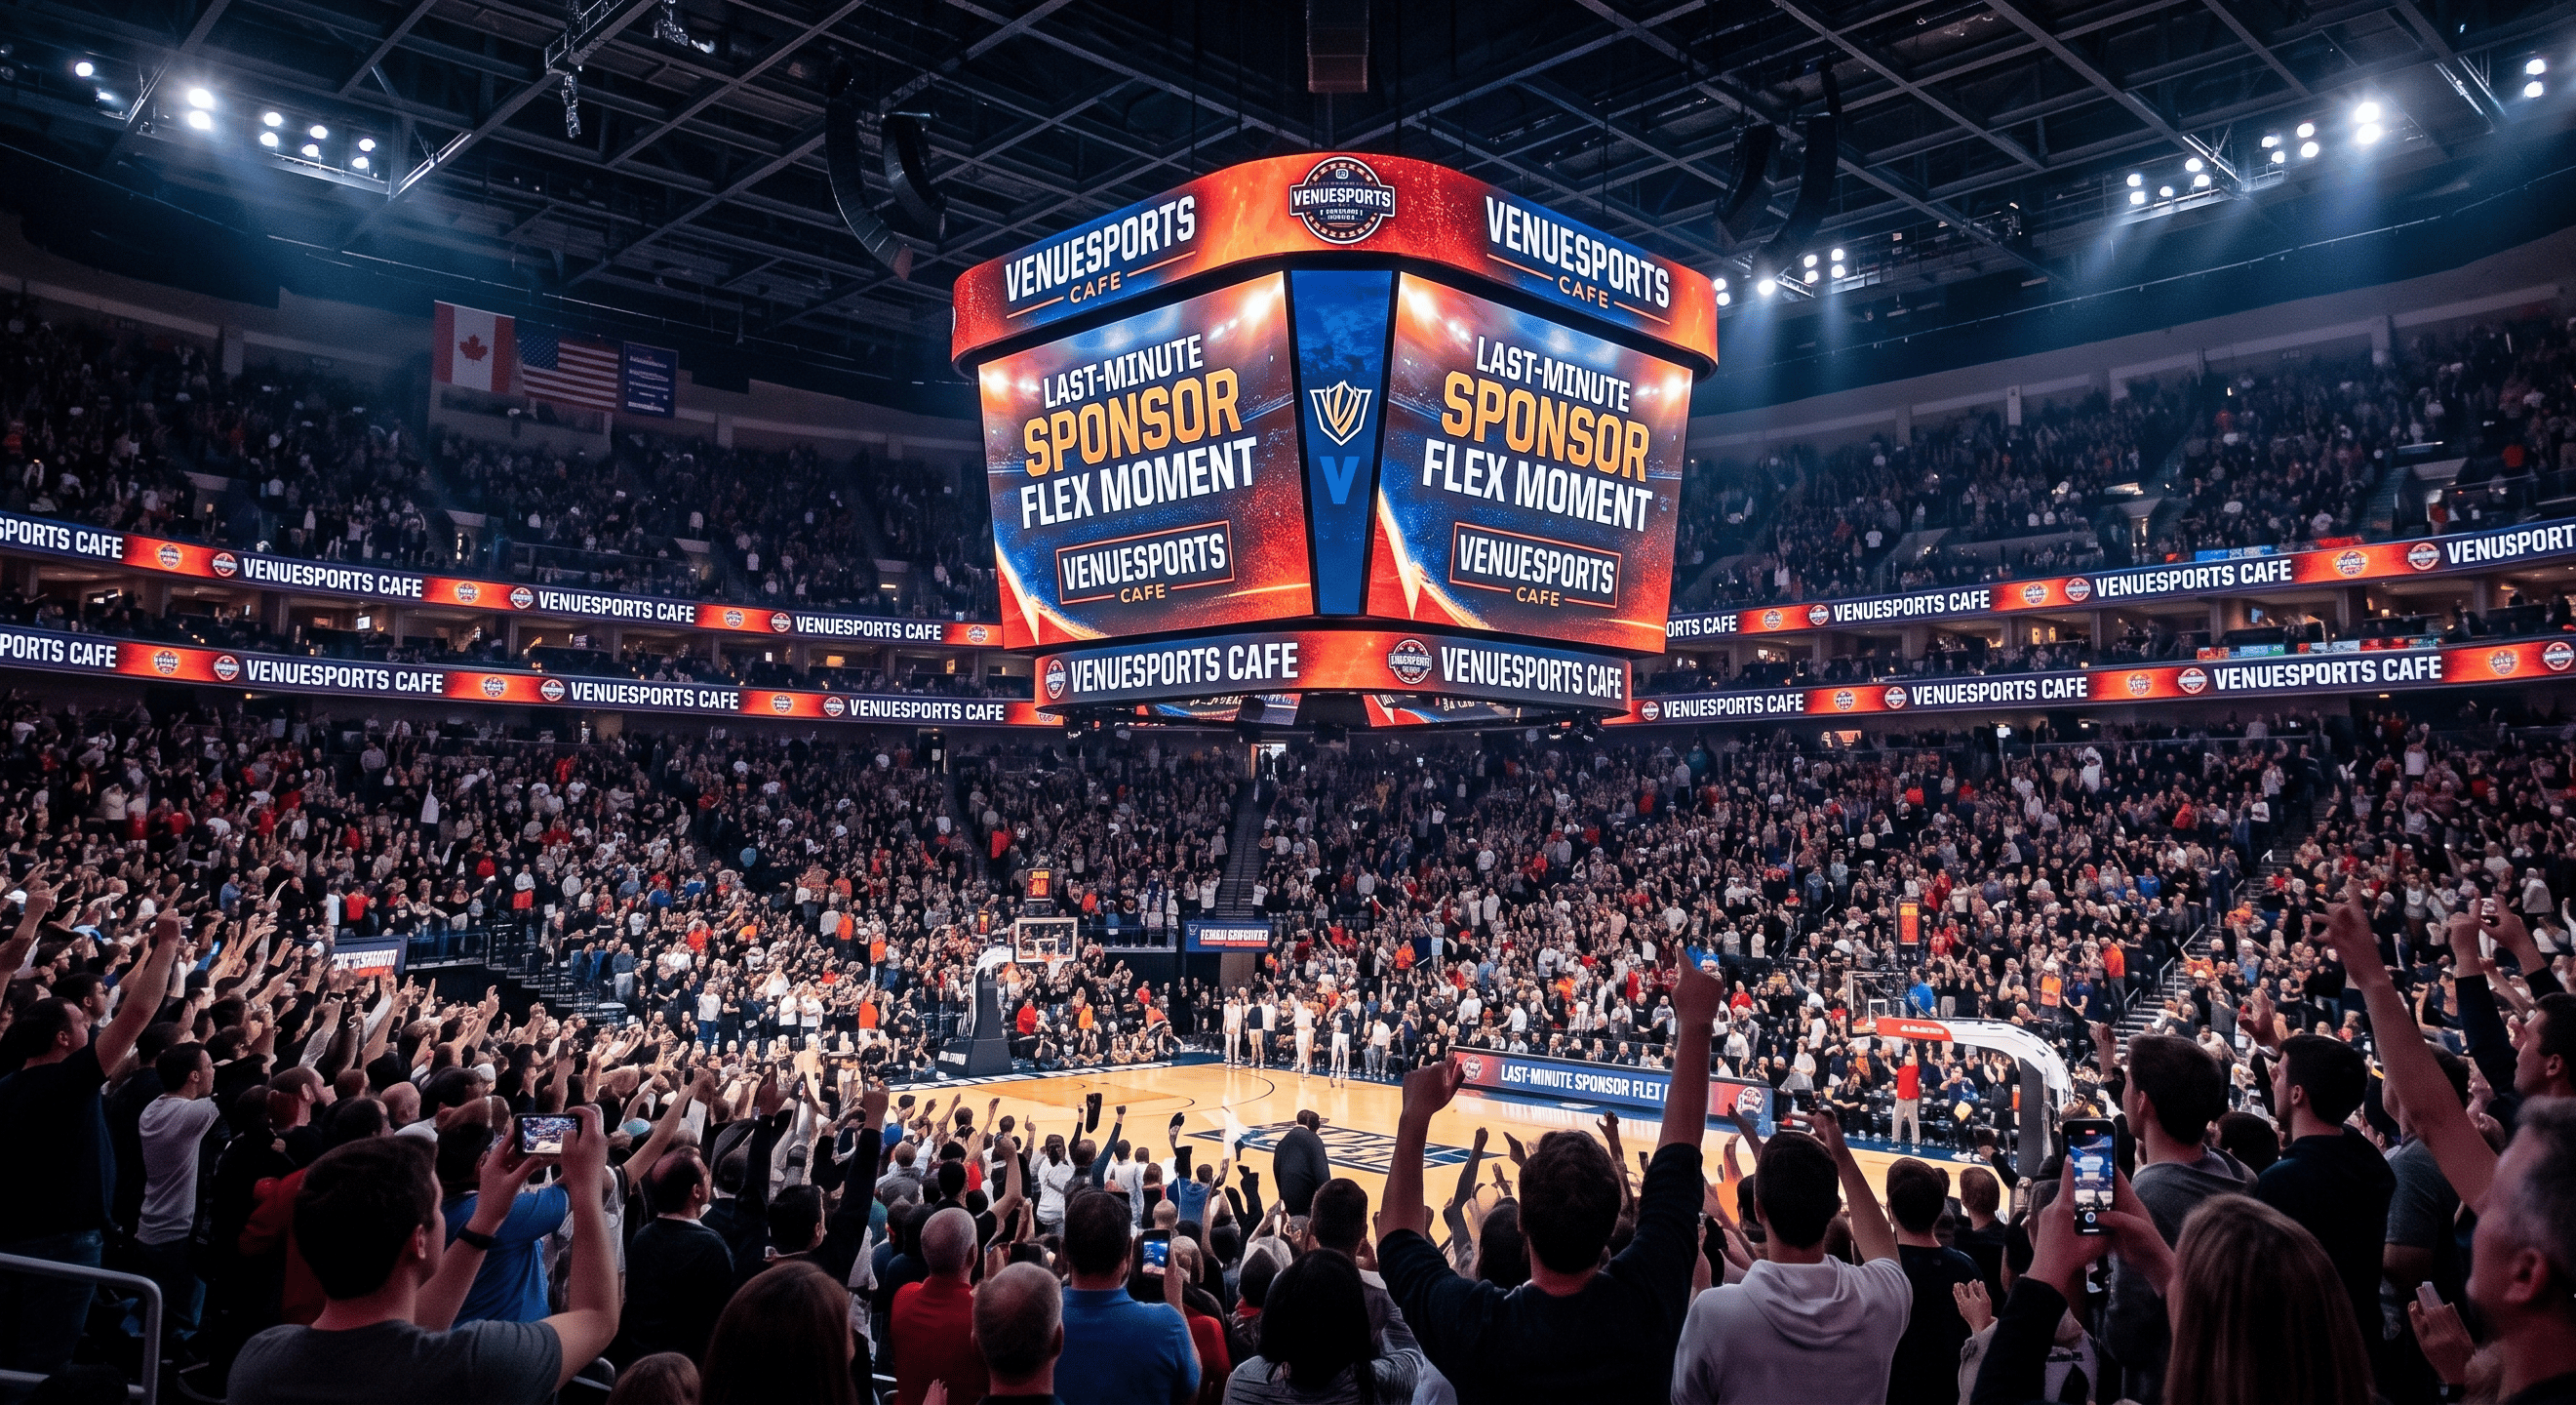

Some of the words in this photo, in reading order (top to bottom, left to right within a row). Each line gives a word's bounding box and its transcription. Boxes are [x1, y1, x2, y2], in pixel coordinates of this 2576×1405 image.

[1292, 187, 1391, 207] VENUESPORTS
[1005, 195, 1196, 302] VENUESPORTS
[1486, 195, 1671, 308] VENUESPORTS
[1069, 270, 1122, 303] CAFE
[1558, 276, 1609, 309] CAFE
[1043, 334, 1204, 409] LAST-MINUTE
[1476, 336, 1631, 413] LAST-MINUTE
[1023, 368, 1243, 478] SPONSOR
[1441, 370, 1651, 482] SPONSOR
[1020, 472, 1094, 530] FLEX
[1099, 436, 1258, 513] MOMENT
[1319, 456, 1361, 505] V
[1422, 438, 1508, 502] FLEX
[1514, 460, 1653, 533] MOMENT
[75, 531, 124, 559] CAFE
[1062, 533, 1227, 590] VENUESPORTS
[243, 557, 374, 592] VENUESPORTS
[377, 575, 423, 598] CAFE
[1459, 534, 1615, 594] VENUESPORTS
[2095, 564, 2236, 598] VENUESPORTS
[2239, 559, 2292, 584] CAFE
[538, 590, 654, 620] VENUESPORTS
[656, 603, 694, 623] CAFE
[1120, 582, 1167, 603] CAFE
[1516, 586, 1562, 608] CAFE
[1833, 594, 1945, 622] VENUESPORTS
[1948, 589, 1991, 612] CAFE
[796, 616, 902, 639] VENUESPORTS
[905, 622, 942, 641] CAFE
[1666, 617, 1701, 639] ORTS
[1703, 614, 1737, 634] CAFE
[0, 633, 64, 662] PORTS
[69, 641, 117, 668] CAFE
[1070, 646, 1221, 693] VENUESPORTS
[1227, 642, 1299, 680] CAFE
[246, 660, 390, 692] VENUESPORTS
[395, 671, 444, 694] CAFE
[1441, 646, 1583, 696] VENUESPORTS
[1587, 663, 1622, 700] CAFE
[2213, 659, 2377, 690] VENUESPORTS
[2383, 655, 2442, 682] CAFE
[571, 681, 694, 707] VENUESPORTS
[698, 689, 739, 710] CAFE
[1663, 696, 1764, 718] VENUESPORTS
[1766, 693, 1804, 713] CAFE
[1912, 680, 2037, 706] VENUESPORTS
[2041, 676, 2087, 699] CAFE
[849, 699, 962, 721] VENUESPORTS
[965, 702, 1005, 722] CAFE
[1500, 1064, 1573, 1089] LAST-MINUTE
[1574, 1073, 1630, 1097] SPONSOR
